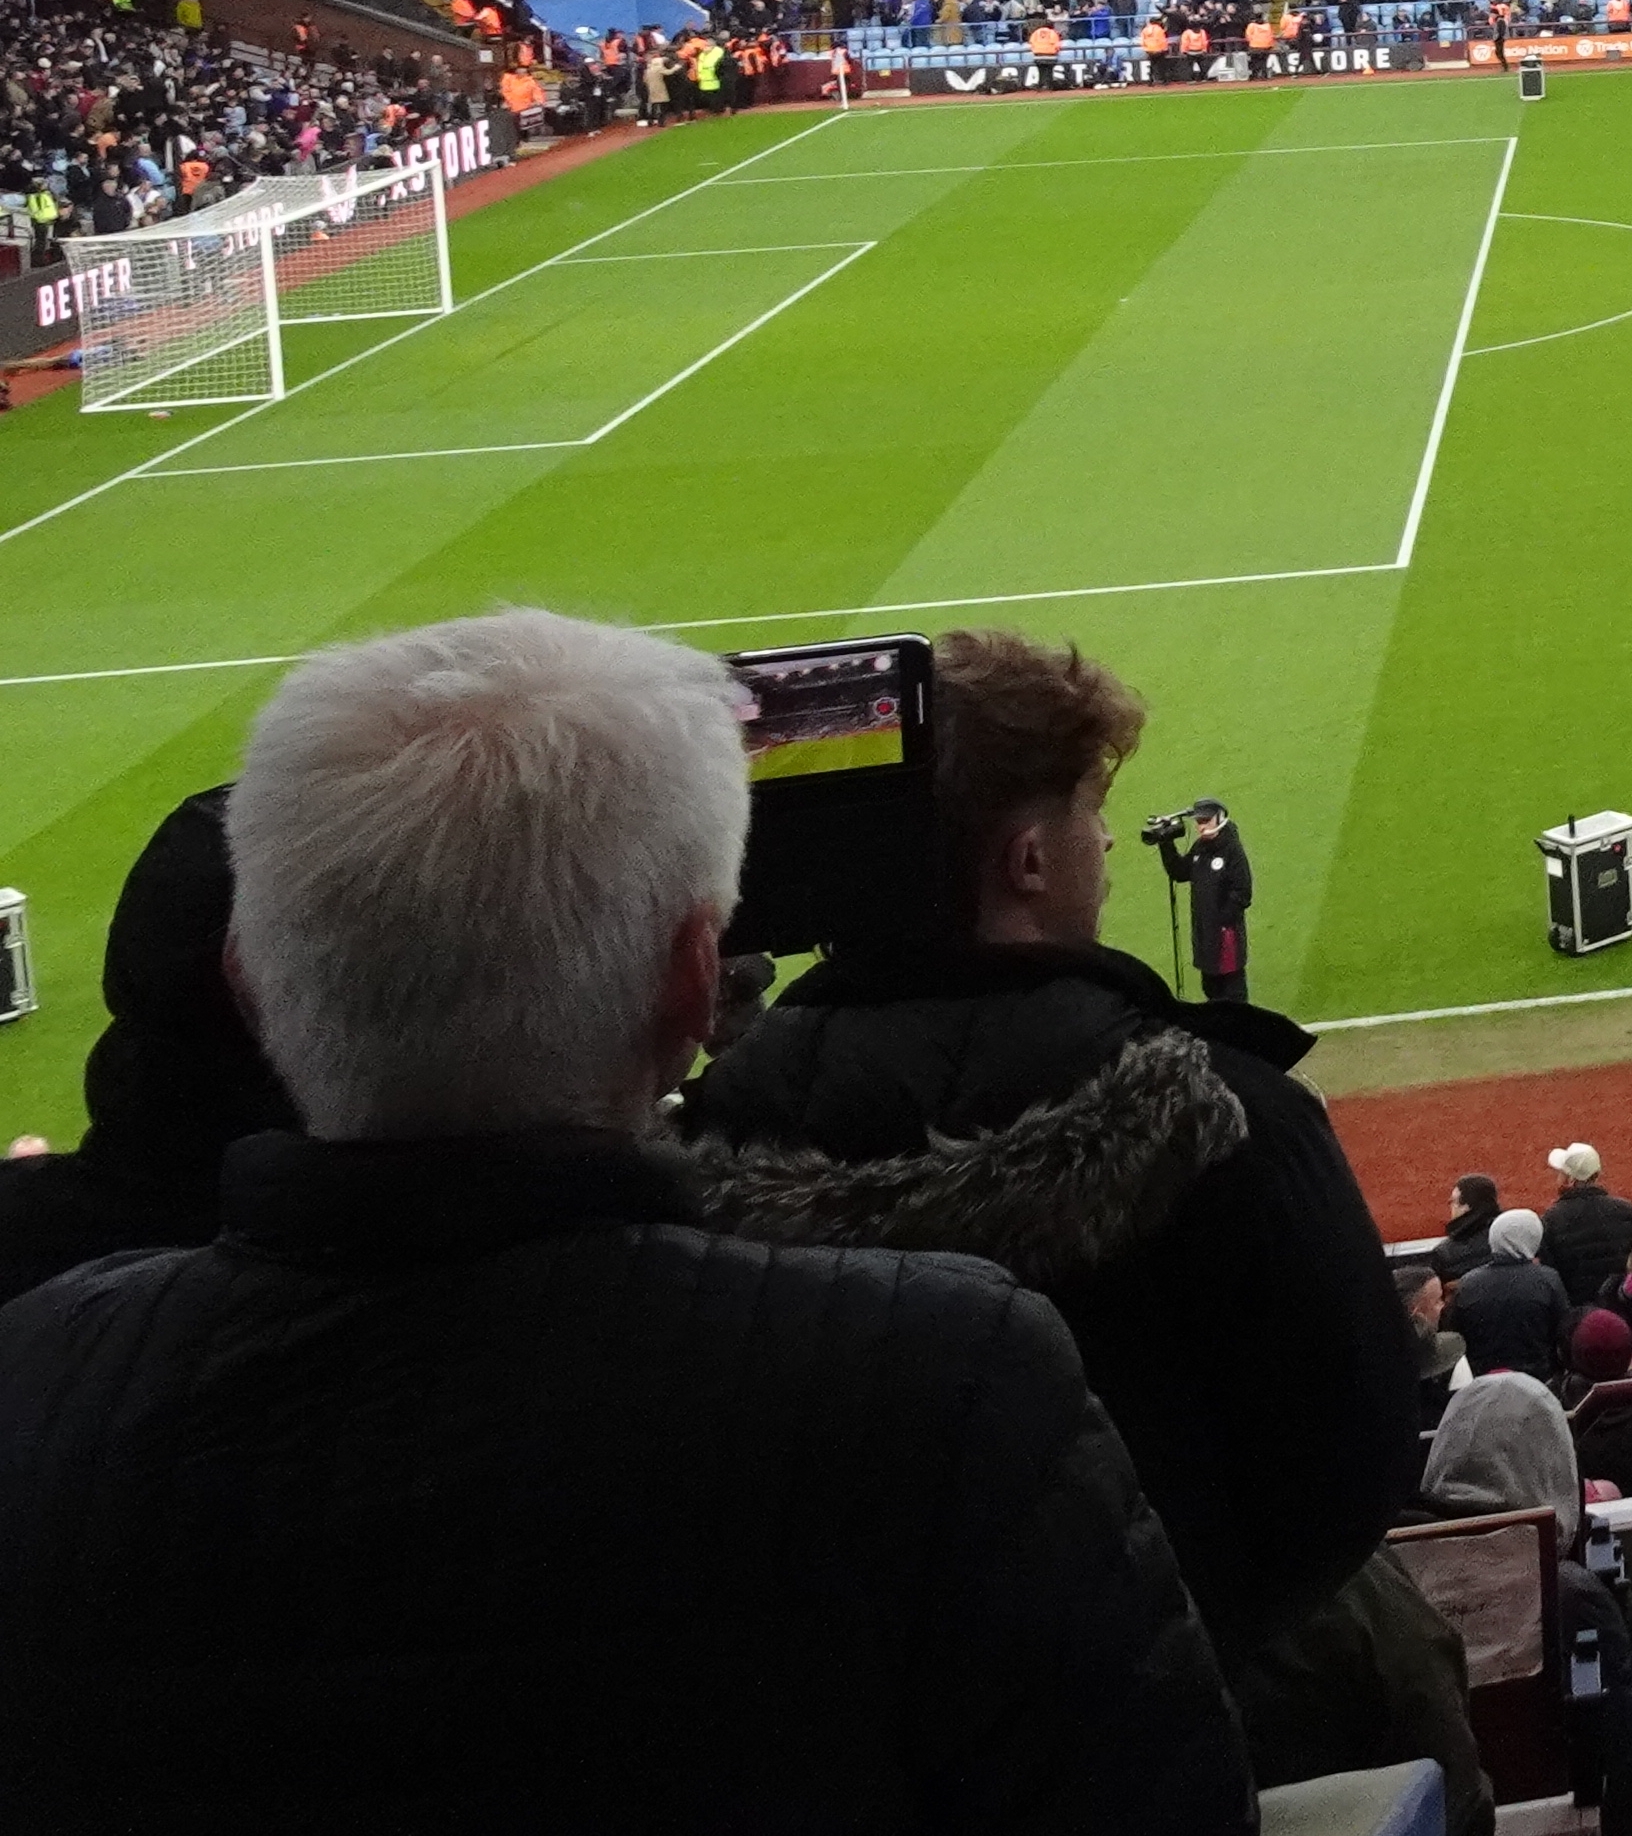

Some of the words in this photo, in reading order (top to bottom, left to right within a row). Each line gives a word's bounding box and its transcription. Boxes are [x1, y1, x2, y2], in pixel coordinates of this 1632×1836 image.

[1267, 48, 1391, 74] ASTORE
[1528, 44, 1568, 55] Nation
[1001, 59, 1151, 87] CASTRE
[377, 119, 492, 206] ASTORE
[37, 257, 131, 326] BETTER
